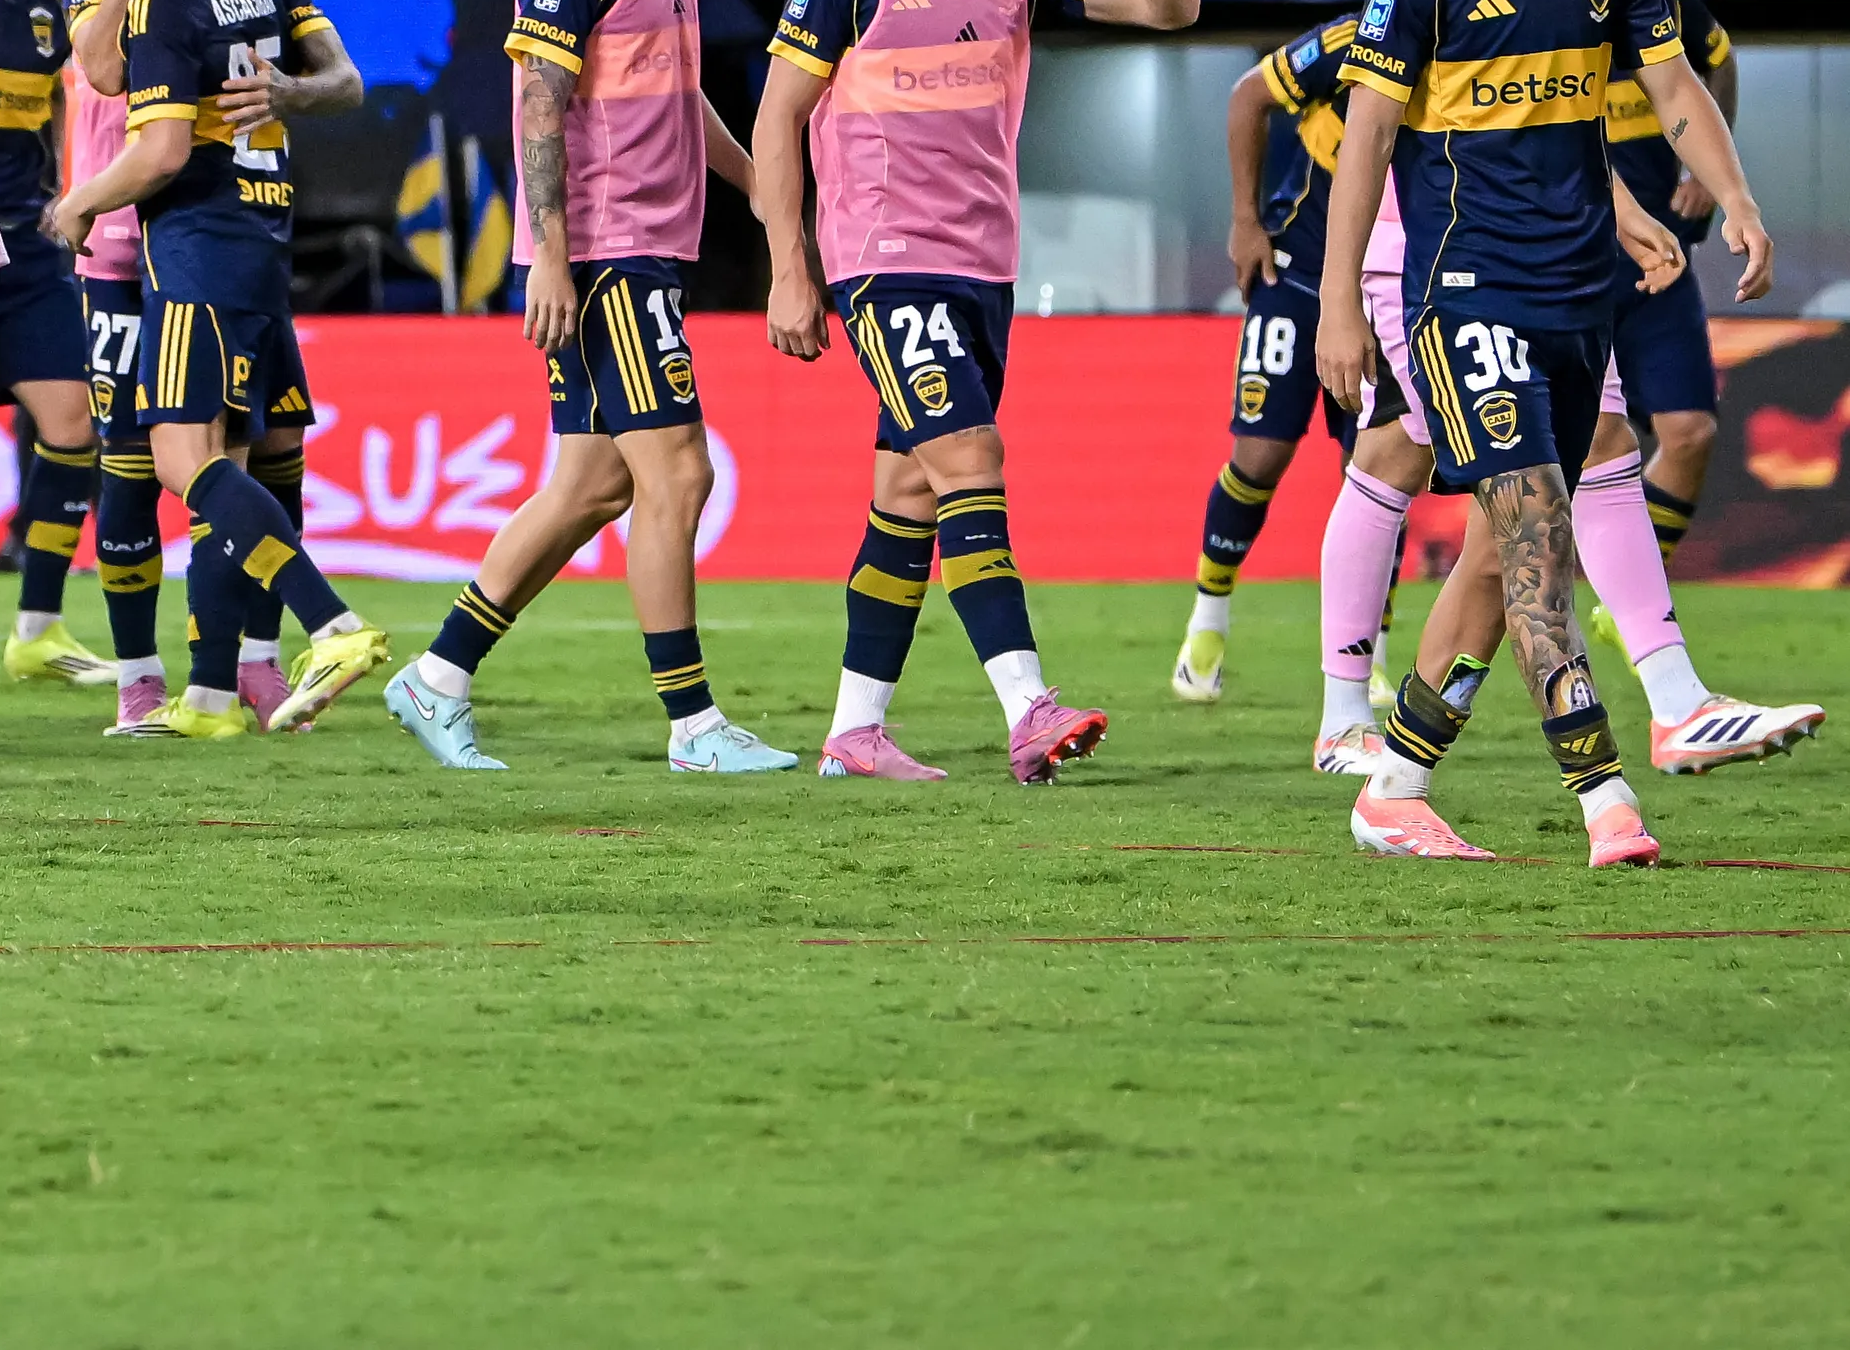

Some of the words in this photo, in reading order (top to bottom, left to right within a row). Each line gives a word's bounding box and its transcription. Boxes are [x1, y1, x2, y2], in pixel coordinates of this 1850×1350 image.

[1360, 23, 1385, 40] LPF
[91, 310, 141, 375] 27
[889, 303, 966, 367] 24
[1240, 315, 1297, 376] 18
[1453, 321, 1532, 393] 30
[1487, 413, 1511, 425] CABJ
